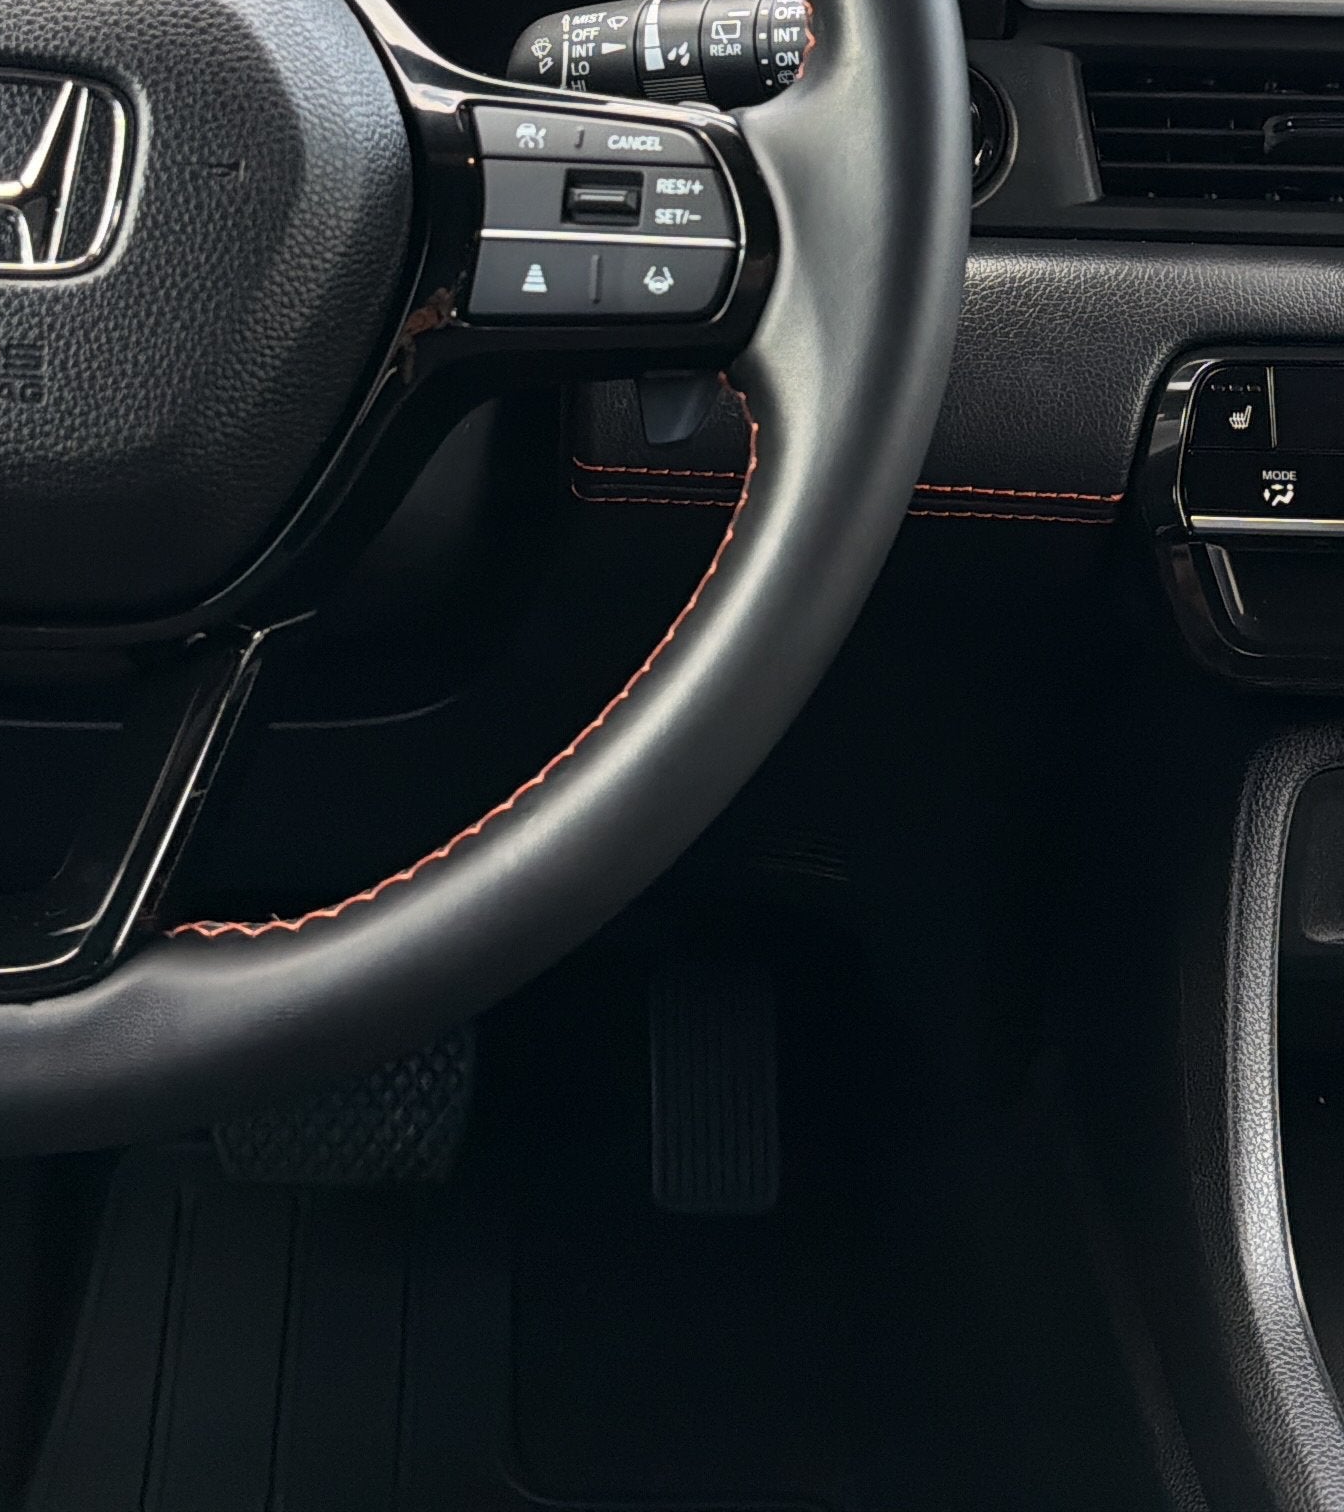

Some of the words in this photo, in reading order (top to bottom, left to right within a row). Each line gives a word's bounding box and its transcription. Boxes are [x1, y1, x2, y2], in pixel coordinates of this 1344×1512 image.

[571, 12, 607, 26] MIST
[774, 6, 806, 20] OFF
[571, 26, 601, 42] OFF
[773, 27, 801, 43] INT
[571, 42, 596, 58] INT
[709, 43, 742, 57] REAR
[775, 51, 800, 67] ON
[570, 61, 590, 76] LO
[607, 134, 663, 152] CANCEL
[1262, 470, 1297, 481] MODE
